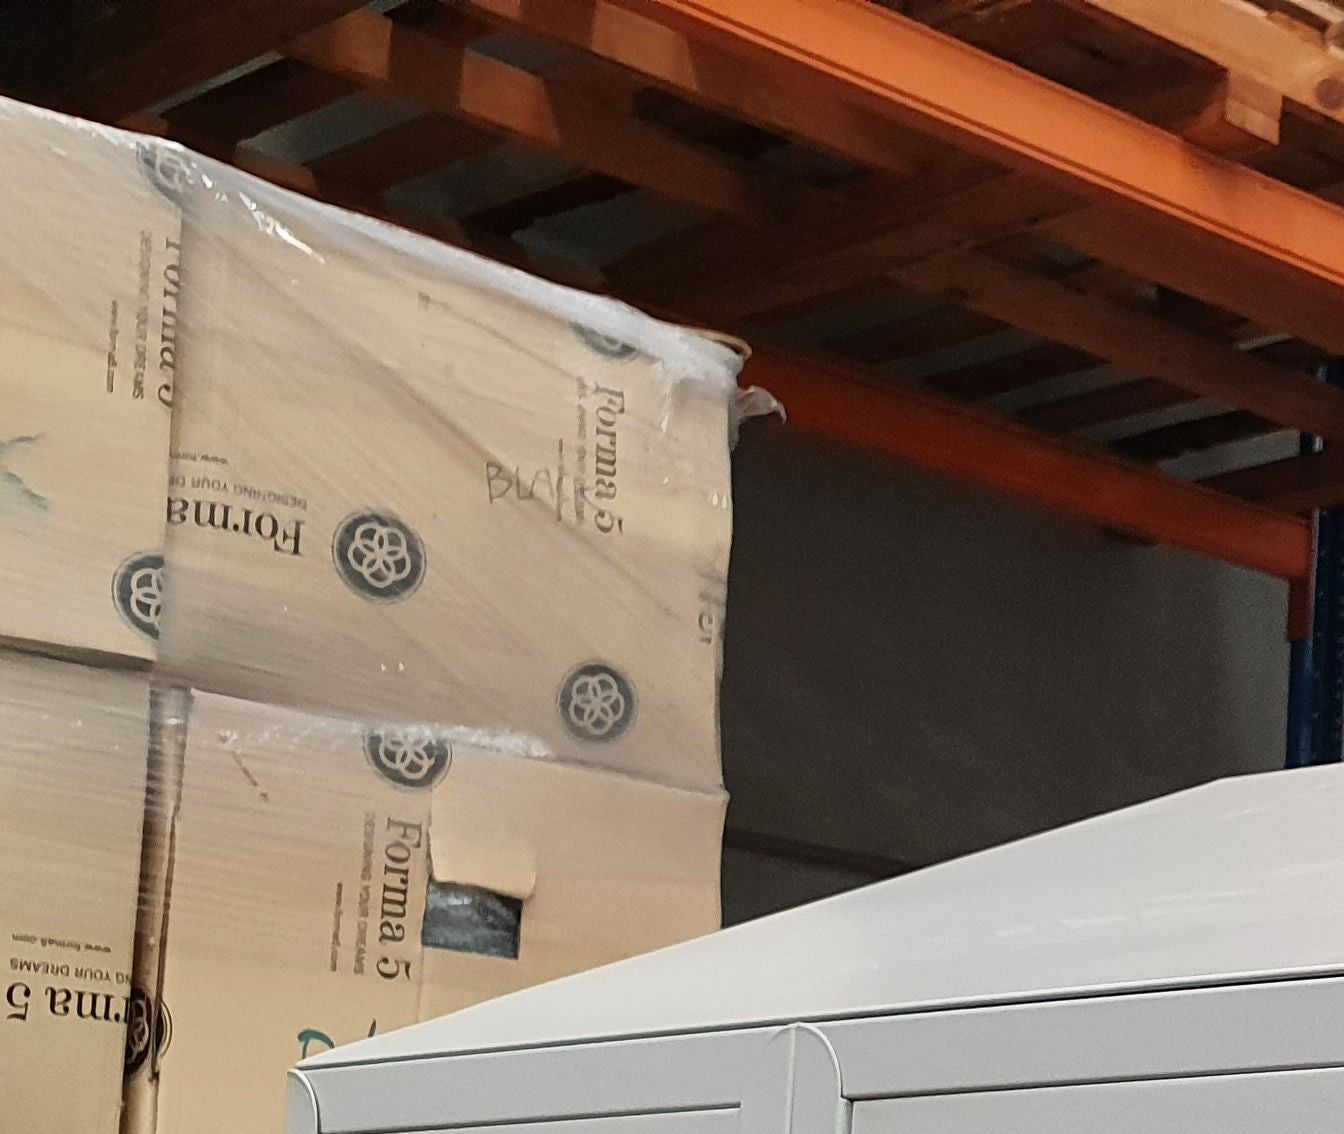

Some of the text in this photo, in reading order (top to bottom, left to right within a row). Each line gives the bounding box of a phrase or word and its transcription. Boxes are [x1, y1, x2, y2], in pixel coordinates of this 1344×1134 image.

[593, 383, 626, 537] Forma 5
[190, 476, 229, 493] YOUR
[167, 497, 306, 557] Forma
[376, 817, 423, 981] Forma 5
[9, 958, 70, 976] DREAMS
[74, 967, 111, 982] YOUR
[5, 982, 129, 1024] rma 5
